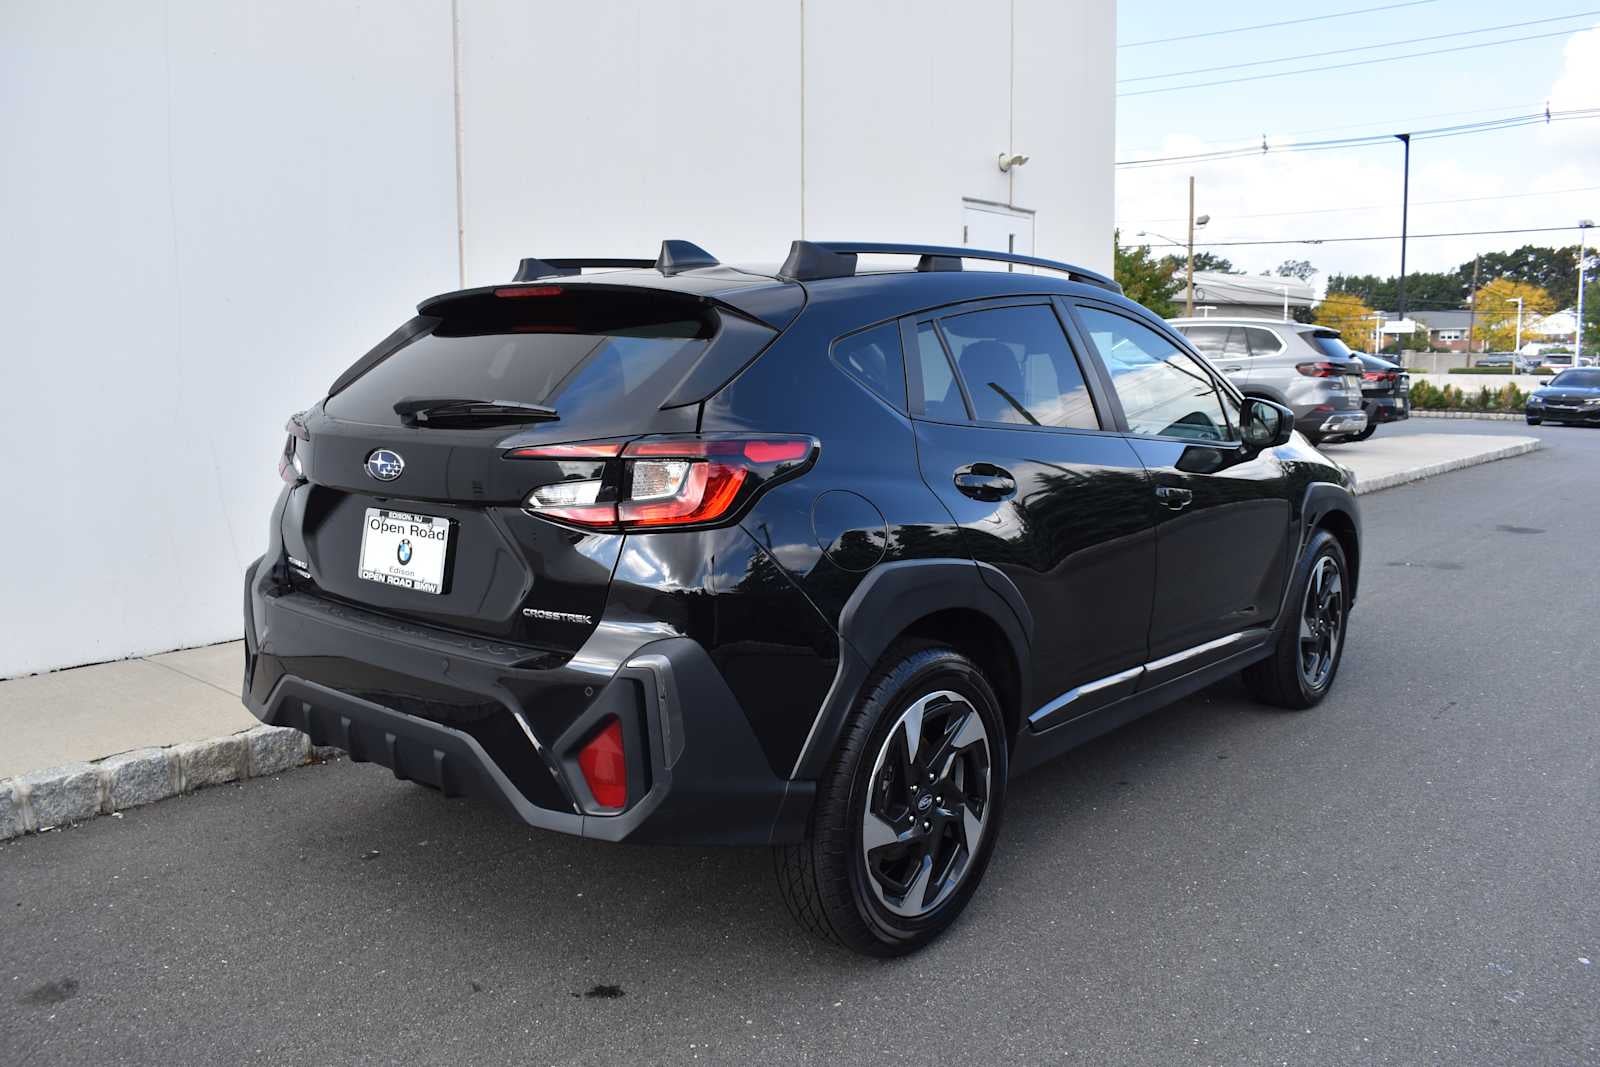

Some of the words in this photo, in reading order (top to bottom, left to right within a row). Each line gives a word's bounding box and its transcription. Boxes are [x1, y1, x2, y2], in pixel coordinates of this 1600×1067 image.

[370, 519, 405, 534] Open
[410, 525, 445, 541] Road
[389, 566, 415, 577] Edison
[362, 571, 386, 582] OPEN
[387, 575, 412, 587] ROAD
[414, 581, 437, 593] BMW
[522, 607, 592, 624] CROSSTREK
